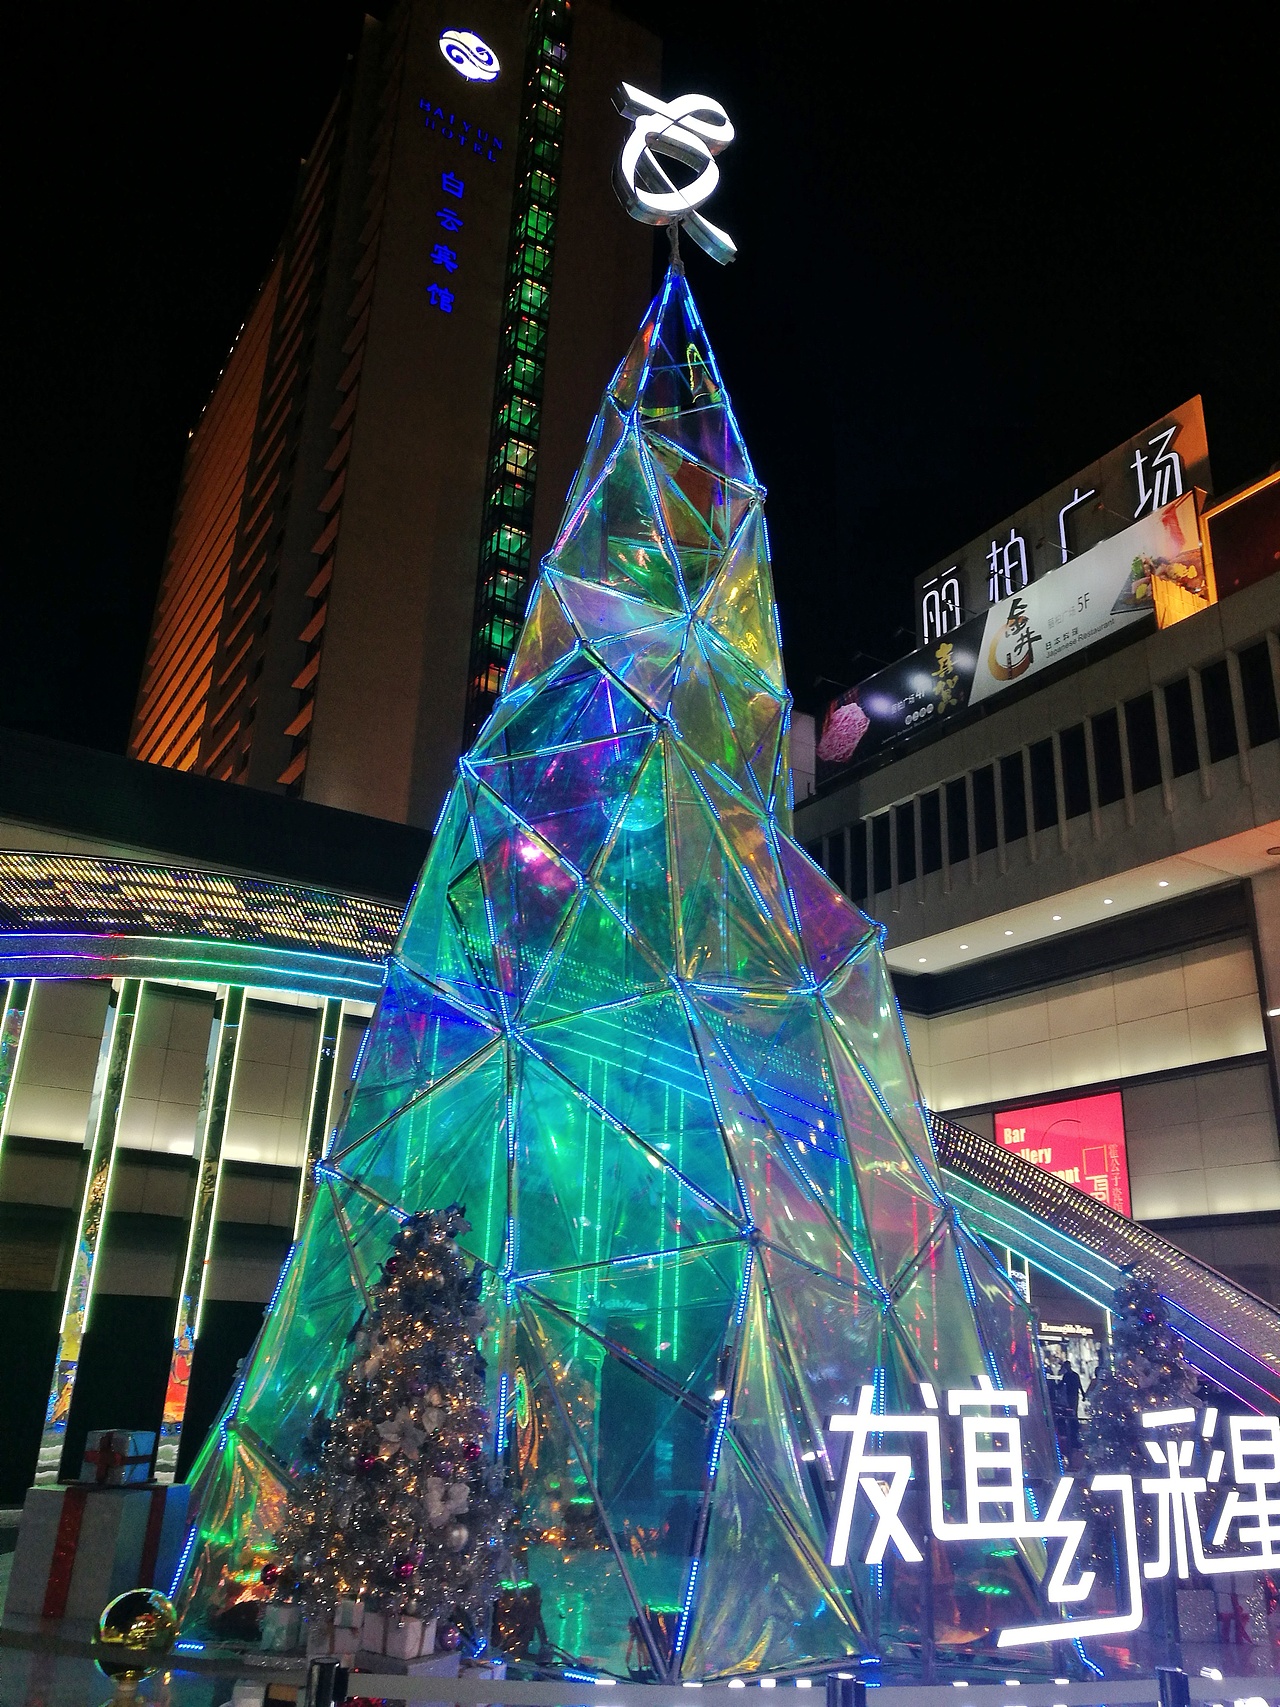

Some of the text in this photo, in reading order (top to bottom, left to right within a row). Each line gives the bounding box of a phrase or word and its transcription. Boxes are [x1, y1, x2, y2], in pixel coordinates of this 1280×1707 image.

[418, 97, 503, 150] BAIYUN
[424, 116, 497, 162] HOTEL
[426, 170, 465, 314] 白云宾馆
[922, 425, 1183, 645] 丽柏广场
[1077, 592, 1090, 613] 5F
[1003, 1128, 1026, 1144] Bar
[1015, 1147, 1052, 1164] llery
